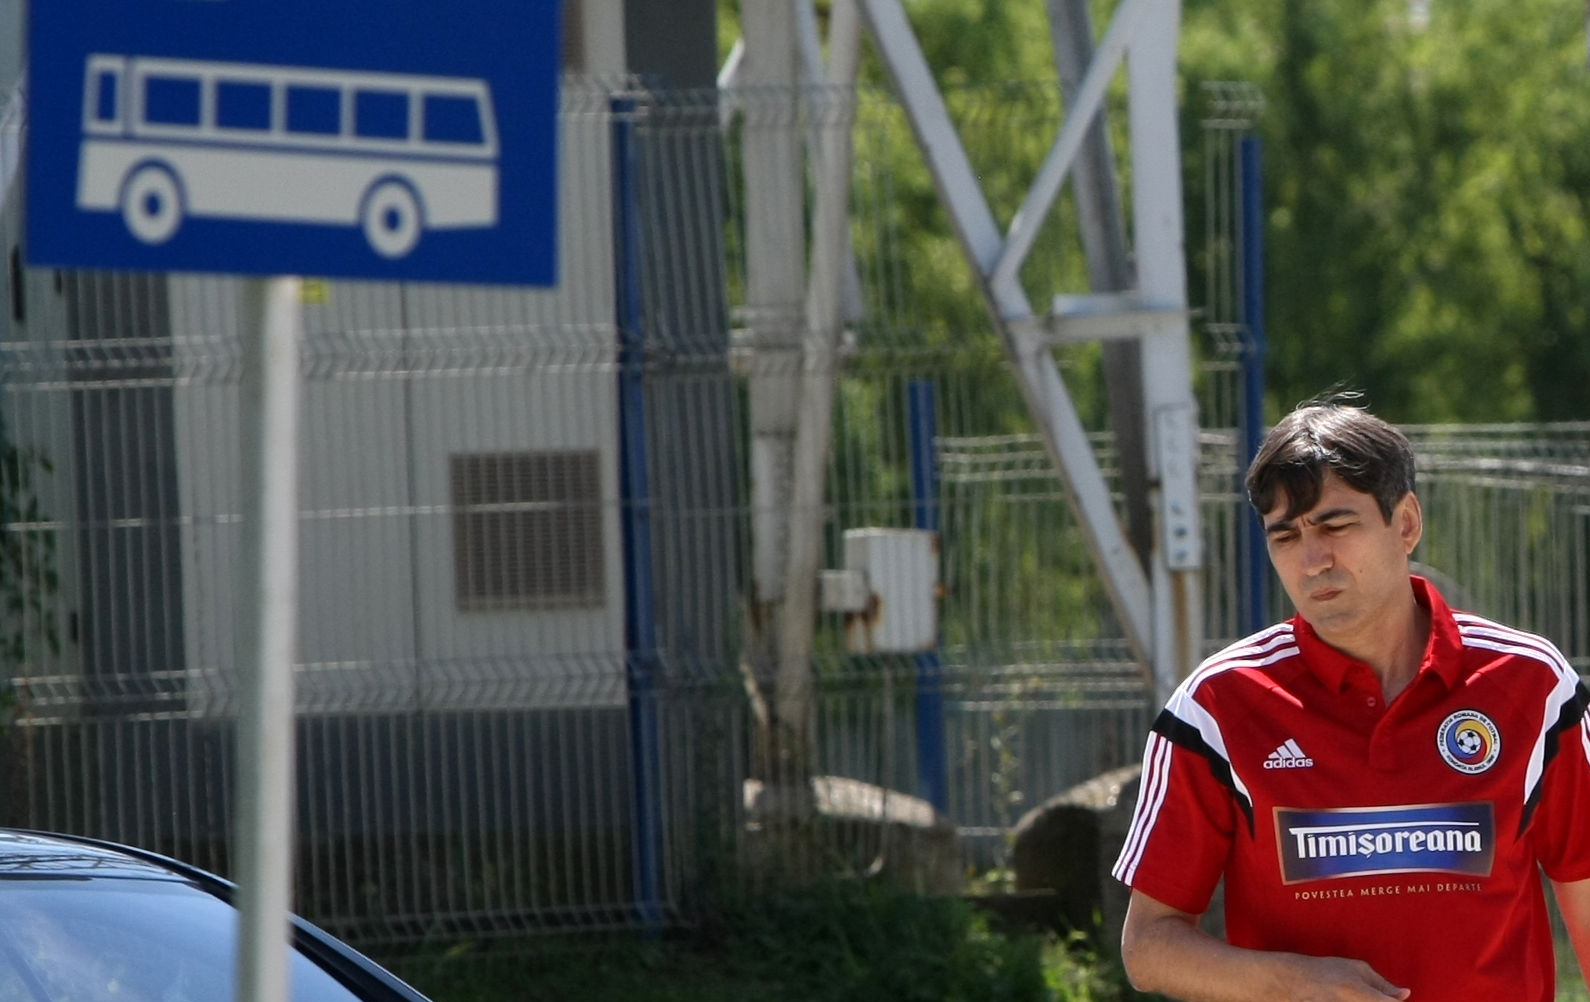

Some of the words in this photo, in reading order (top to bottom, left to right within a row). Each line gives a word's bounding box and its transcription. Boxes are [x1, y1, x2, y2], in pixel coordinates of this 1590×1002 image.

[1263, 755, 1314, 770] adidas
[1295, 889, 1354, 900] POVESTEA
[1360, 886, 1401, 896] MERGE
[1407, 884, 1430, 893] MAI
[1437, 883, 1482, 893] DEPARTE
